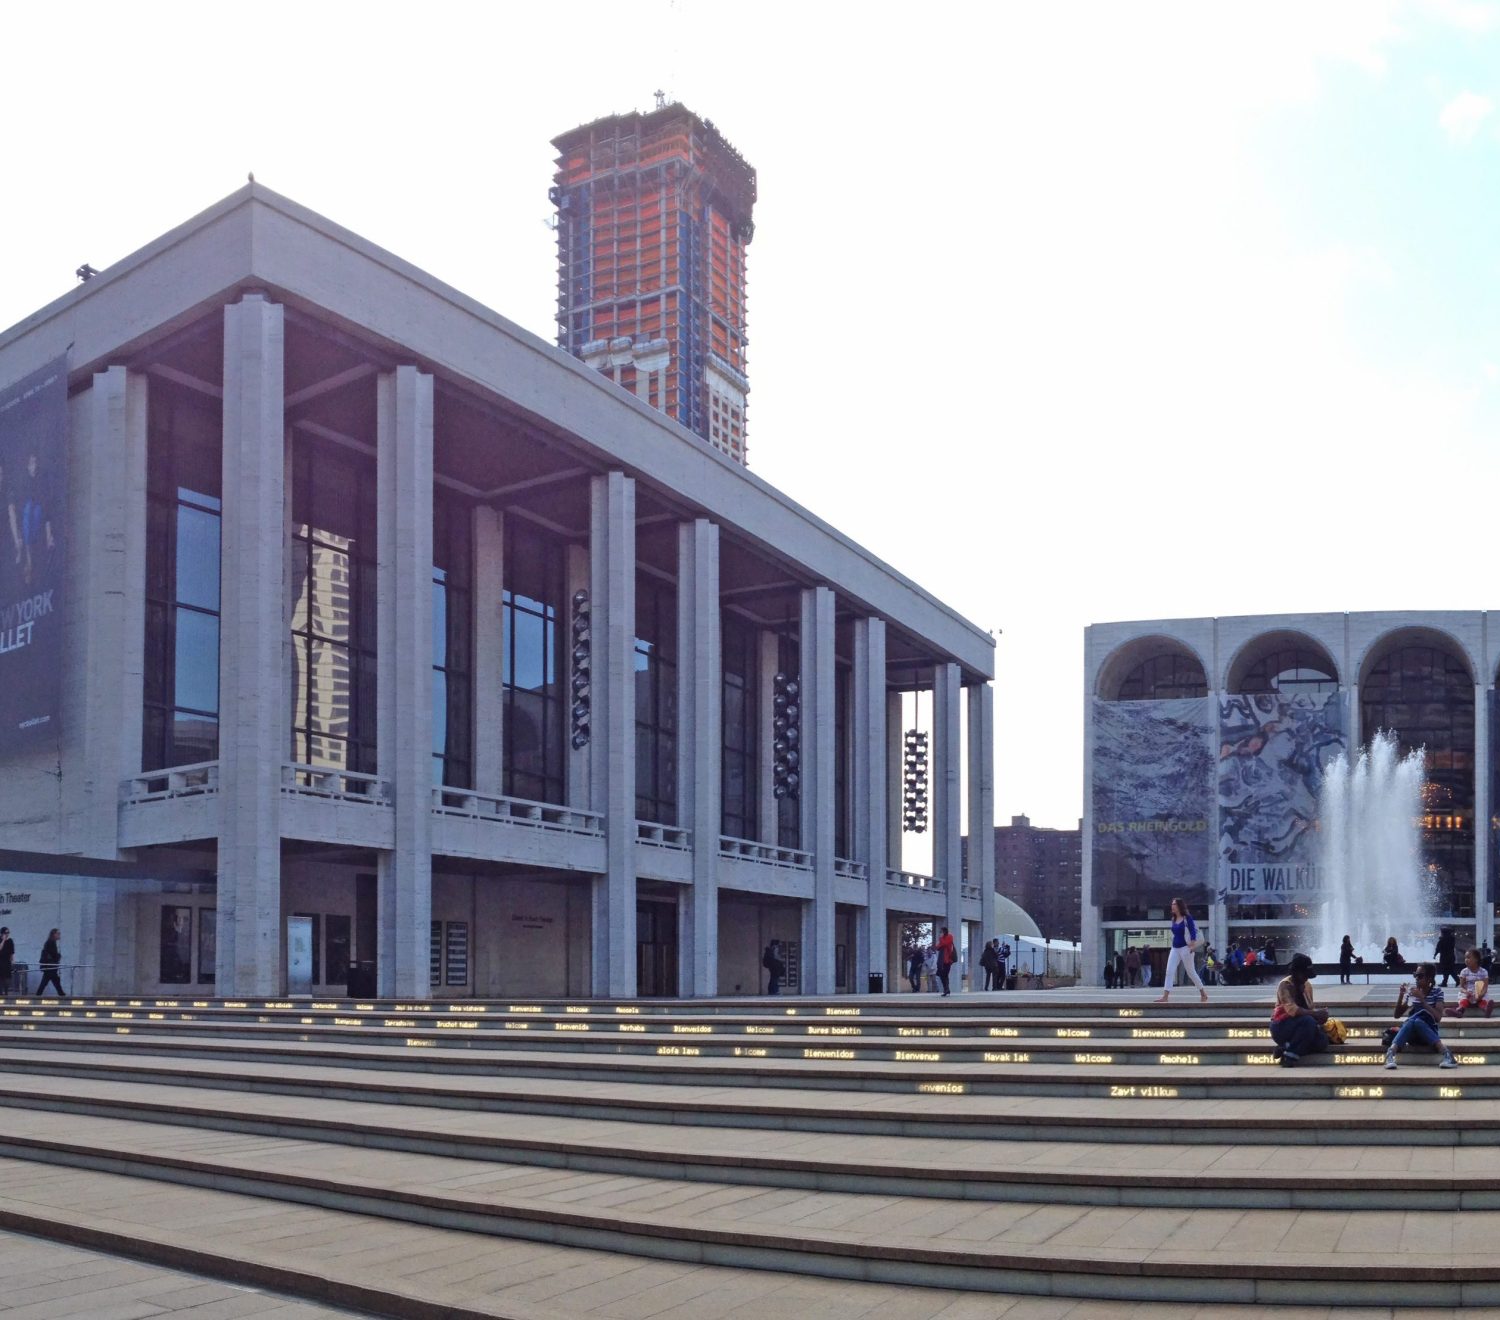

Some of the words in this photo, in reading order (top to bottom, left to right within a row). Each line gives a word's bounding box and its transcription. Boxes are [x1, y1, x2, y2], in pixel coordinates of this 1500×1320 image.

[15, 589, 54, 624] YORK
[1098, 821, 1127, 834] DAS
[1128, 820, 1208, 834] RHEINGOLD
[1230, 867, 1256, 891] DIE
[1262, 861, 1328, 891] WALKÜR
[620, 1024, 645, 1032] Merhaba
[1057, 1029, 1090, 1037] Welcome
[1132, 1030, 1185, 1038] Bienvenidos
[734, 1048, 766, 1056] Wlcome
[804, 1050, 854, 1058] Bienvenidos
[895, 1052, 940, 1060] Bienvenue
[1075, 1054, 1112, 1062] Welcome
[1160, 1055, 1199, 1064] Amohela
